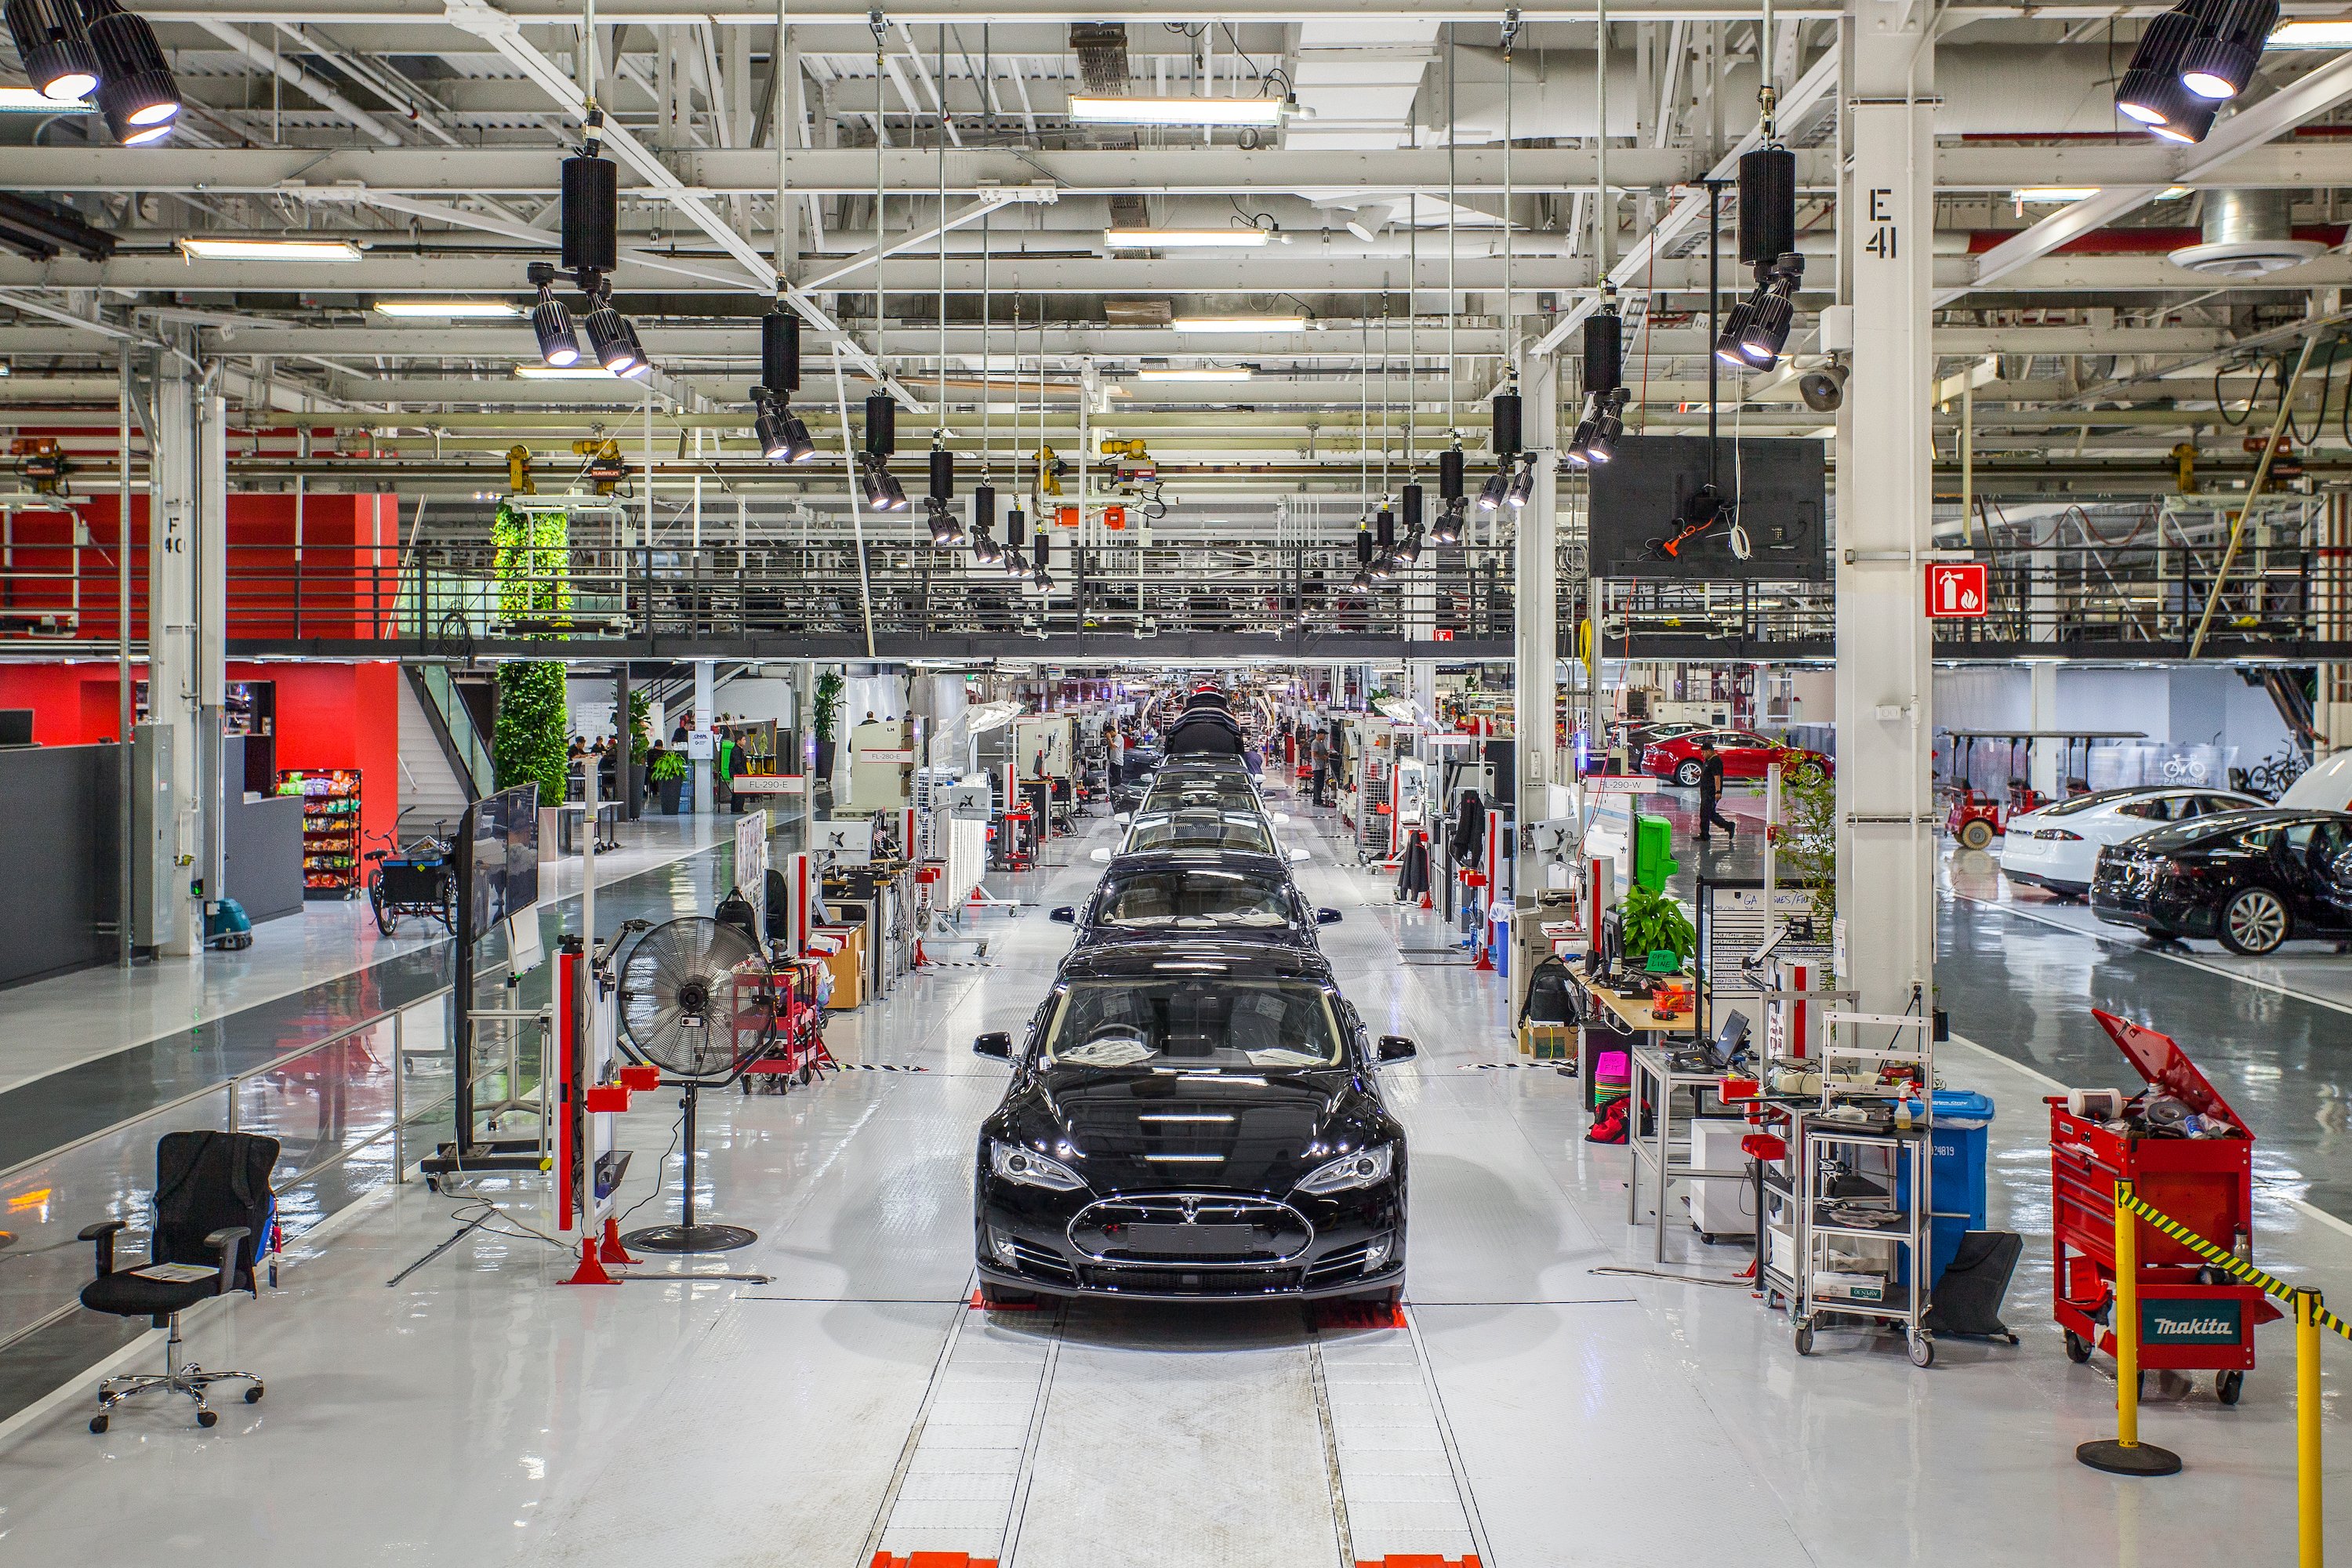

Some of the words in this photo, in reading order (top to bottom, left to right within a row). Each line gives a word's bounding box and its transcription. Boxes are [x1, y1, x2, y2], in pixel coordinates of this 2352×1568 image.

[1870, 189, 1891, 221] E
[1866, 227, 1896, 259] 41
[169, 517, 180, 533] F
[1744, 894, 1757, 906] GA
